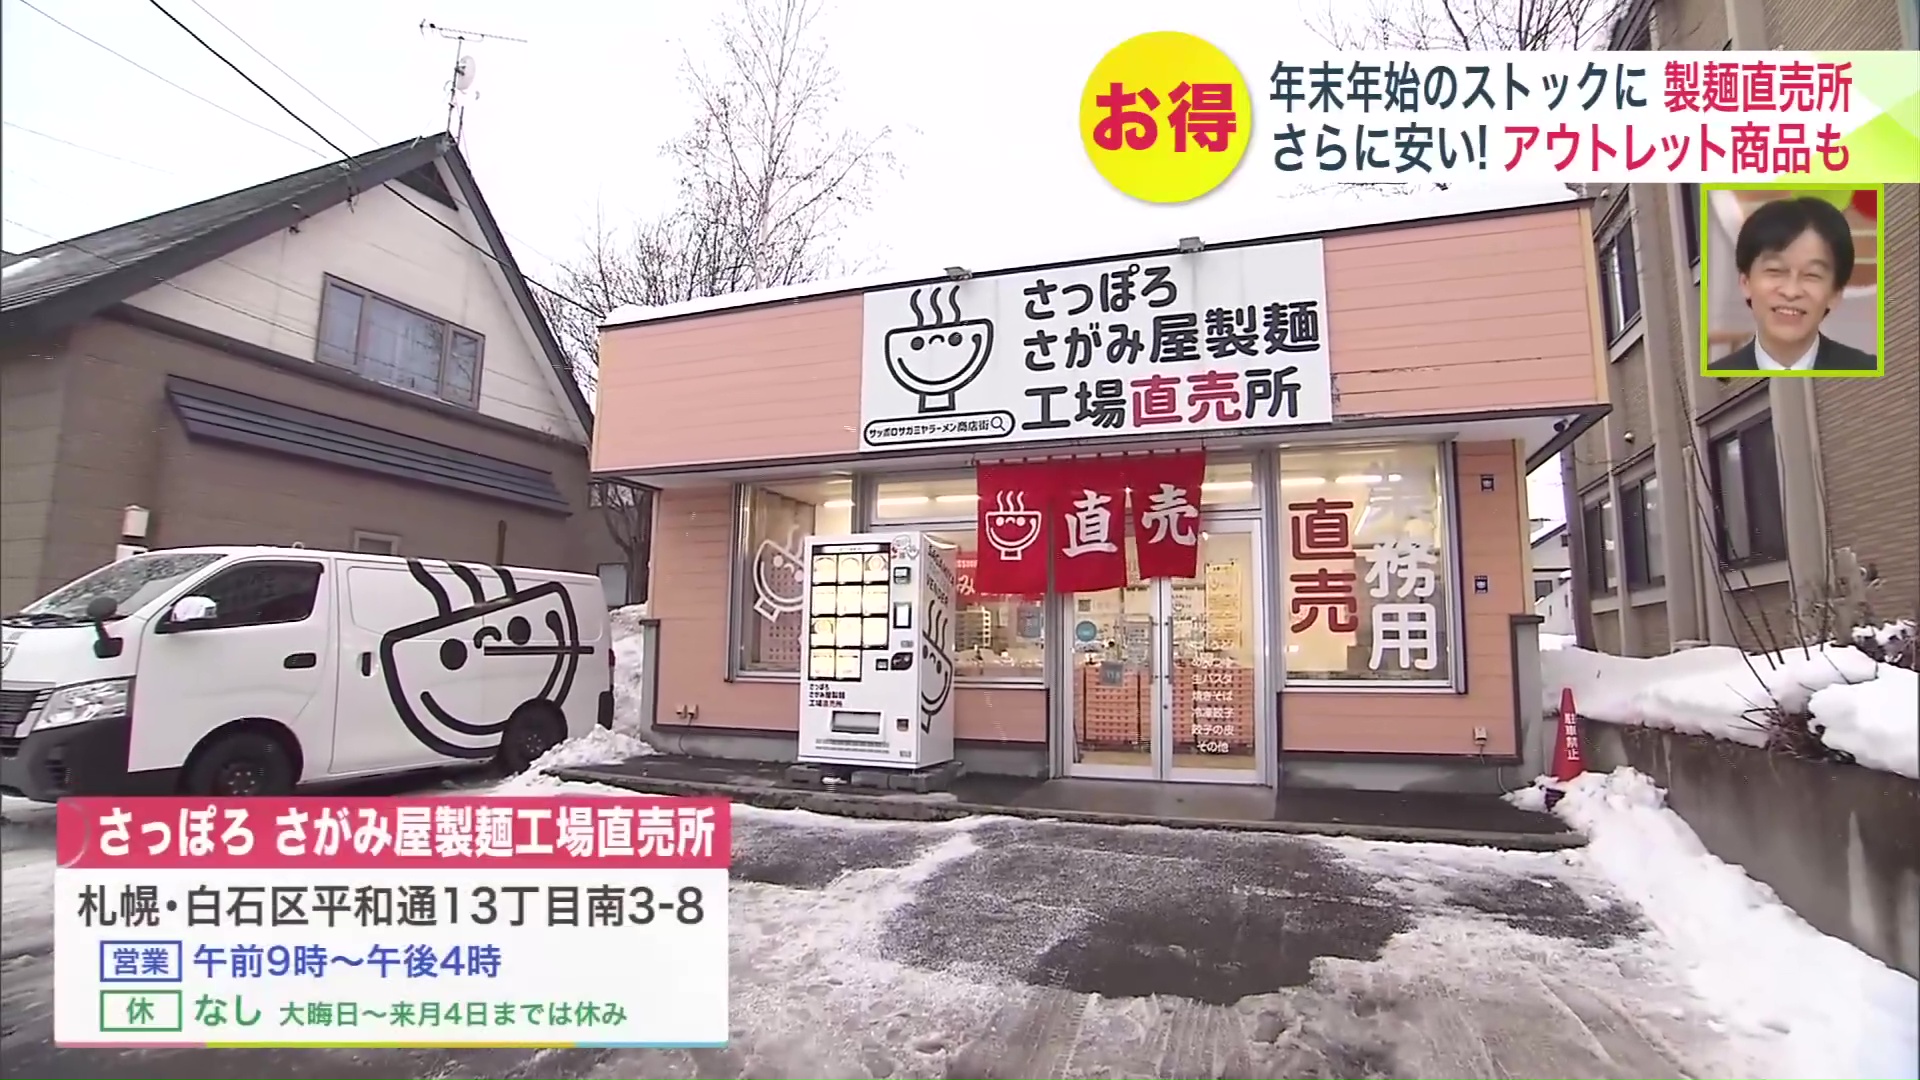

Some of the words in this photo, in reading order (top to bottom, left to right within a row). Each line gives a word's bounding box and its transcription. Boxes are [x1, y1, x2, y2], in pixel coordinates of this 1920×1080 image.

[1022, 263, 1179, 320] さっぽろ
[1022, 300, 1322, 372] さがみ屋製麺
[1021, 366, 1302, 431] 工場直売所
[1061, 483, 1200, 558] 直売
[1287, 497, 1359, 634] 直売
[1197, 740, 1229, 753] その他
